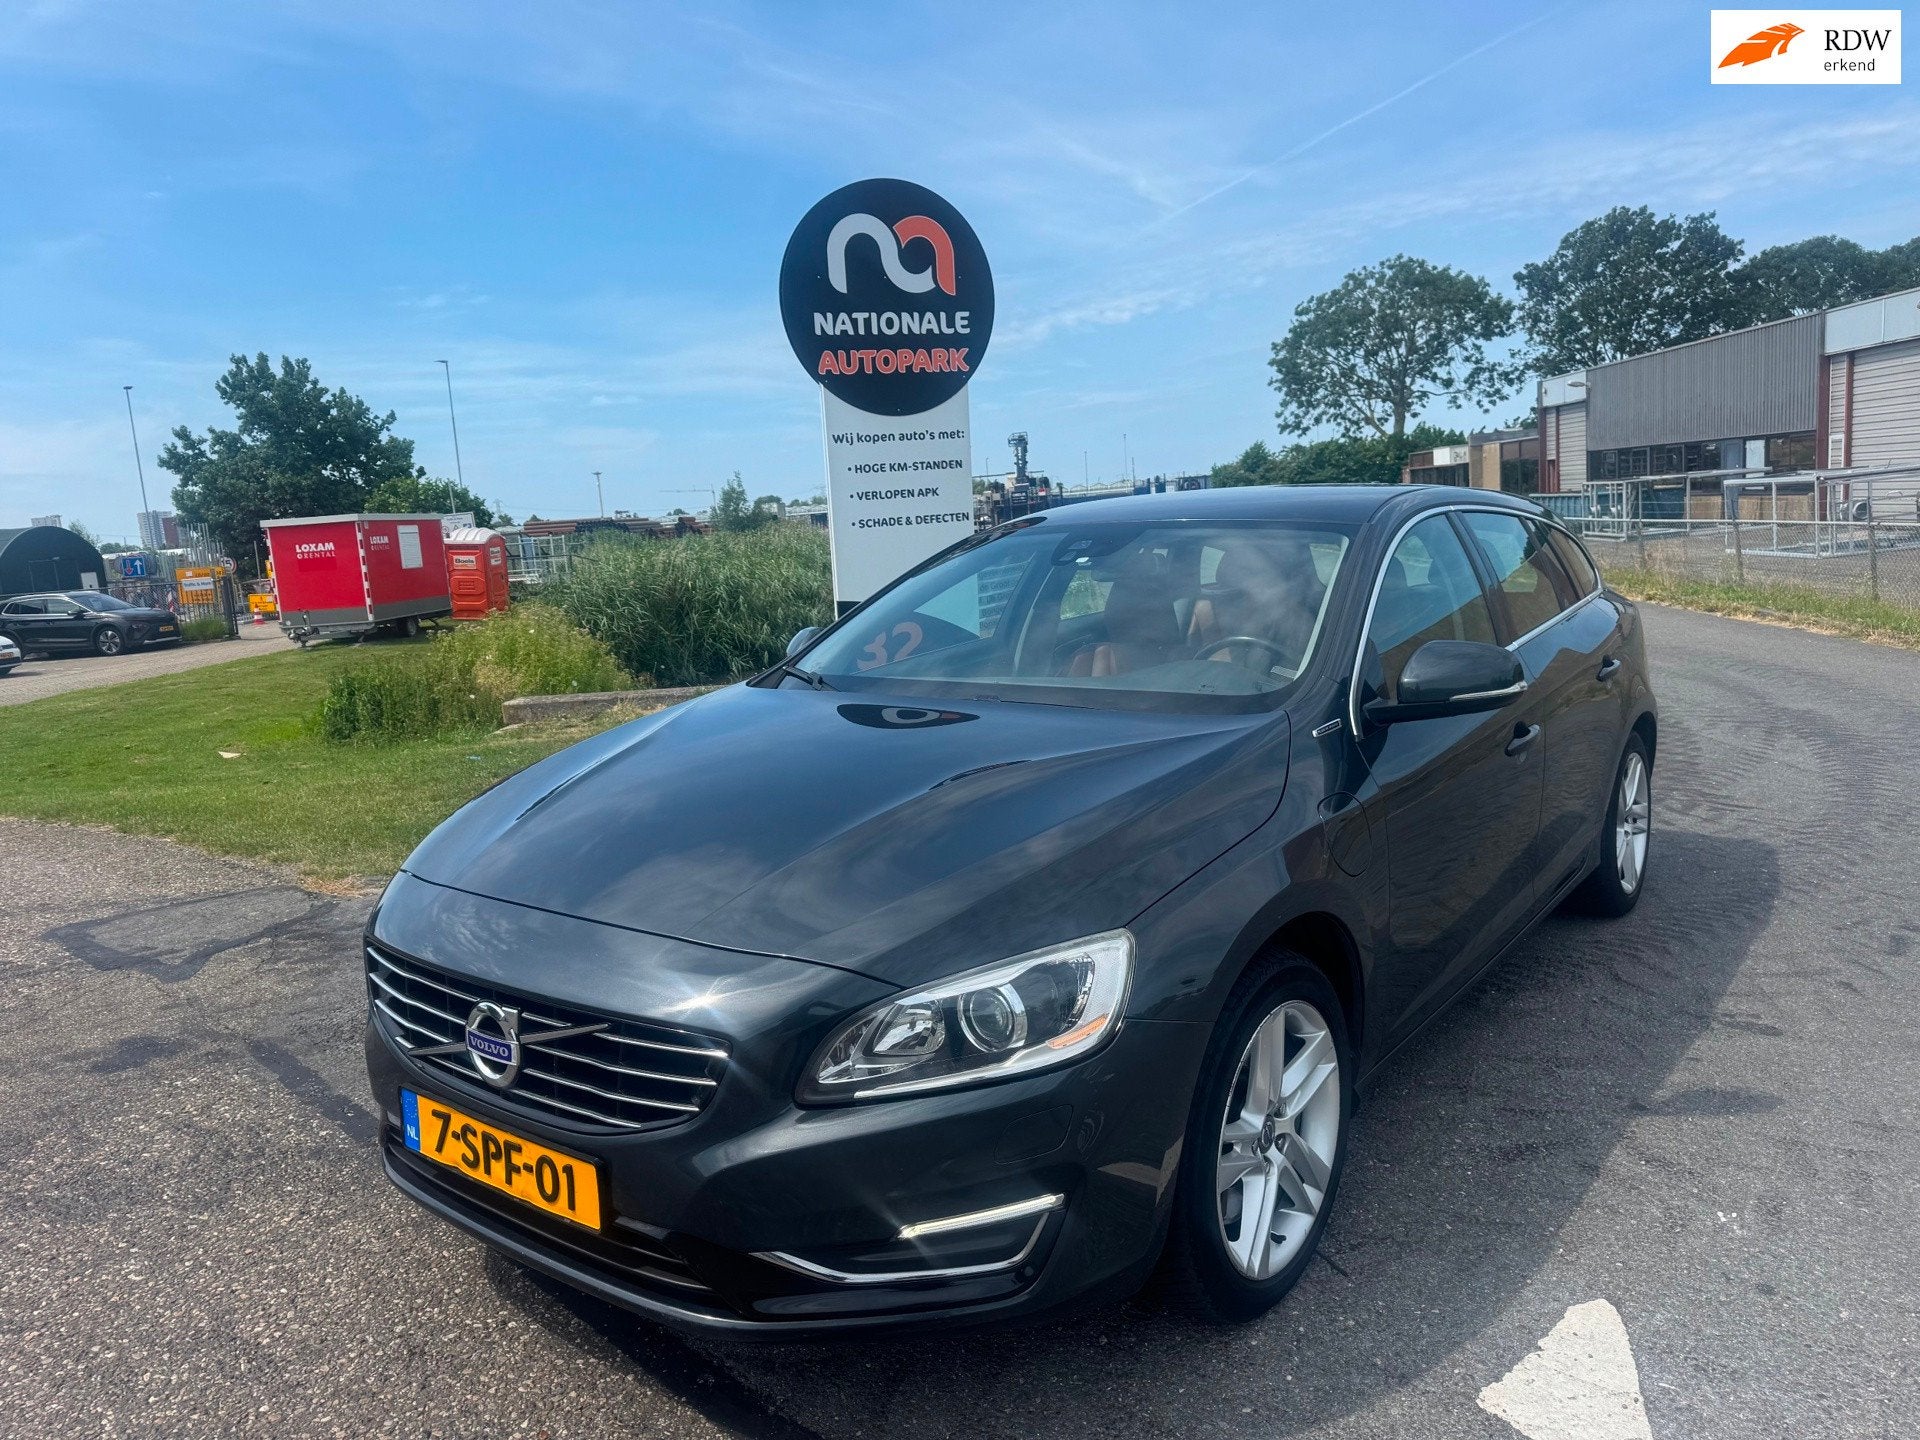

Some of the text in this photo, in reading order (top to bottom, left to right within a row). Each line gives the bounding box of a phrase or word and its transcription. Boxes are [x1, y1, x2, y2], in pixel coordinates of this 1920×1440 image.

[813, 311, 971, 336] NATIONALE
[818, 347, 970, 375] AUTOPARK
[832, 428, 965, 446] Wij kopen auto's met:
[854, 459, 963, 474] HOGE KM-STANDEN
[856, 487, 940, 501] VERLOPEN APK
[858, 511, 970, 529] SCHADE & DEFECTEN
[295, 542, 335, 554] LOXAM
[369, 535, 390, 545] LOXAM
[469, 1034, 510, 1058] VOLVO
[406, 1123, 419, 1142] NL
[431, 1108, 577, 1212] 7-SPF-01
